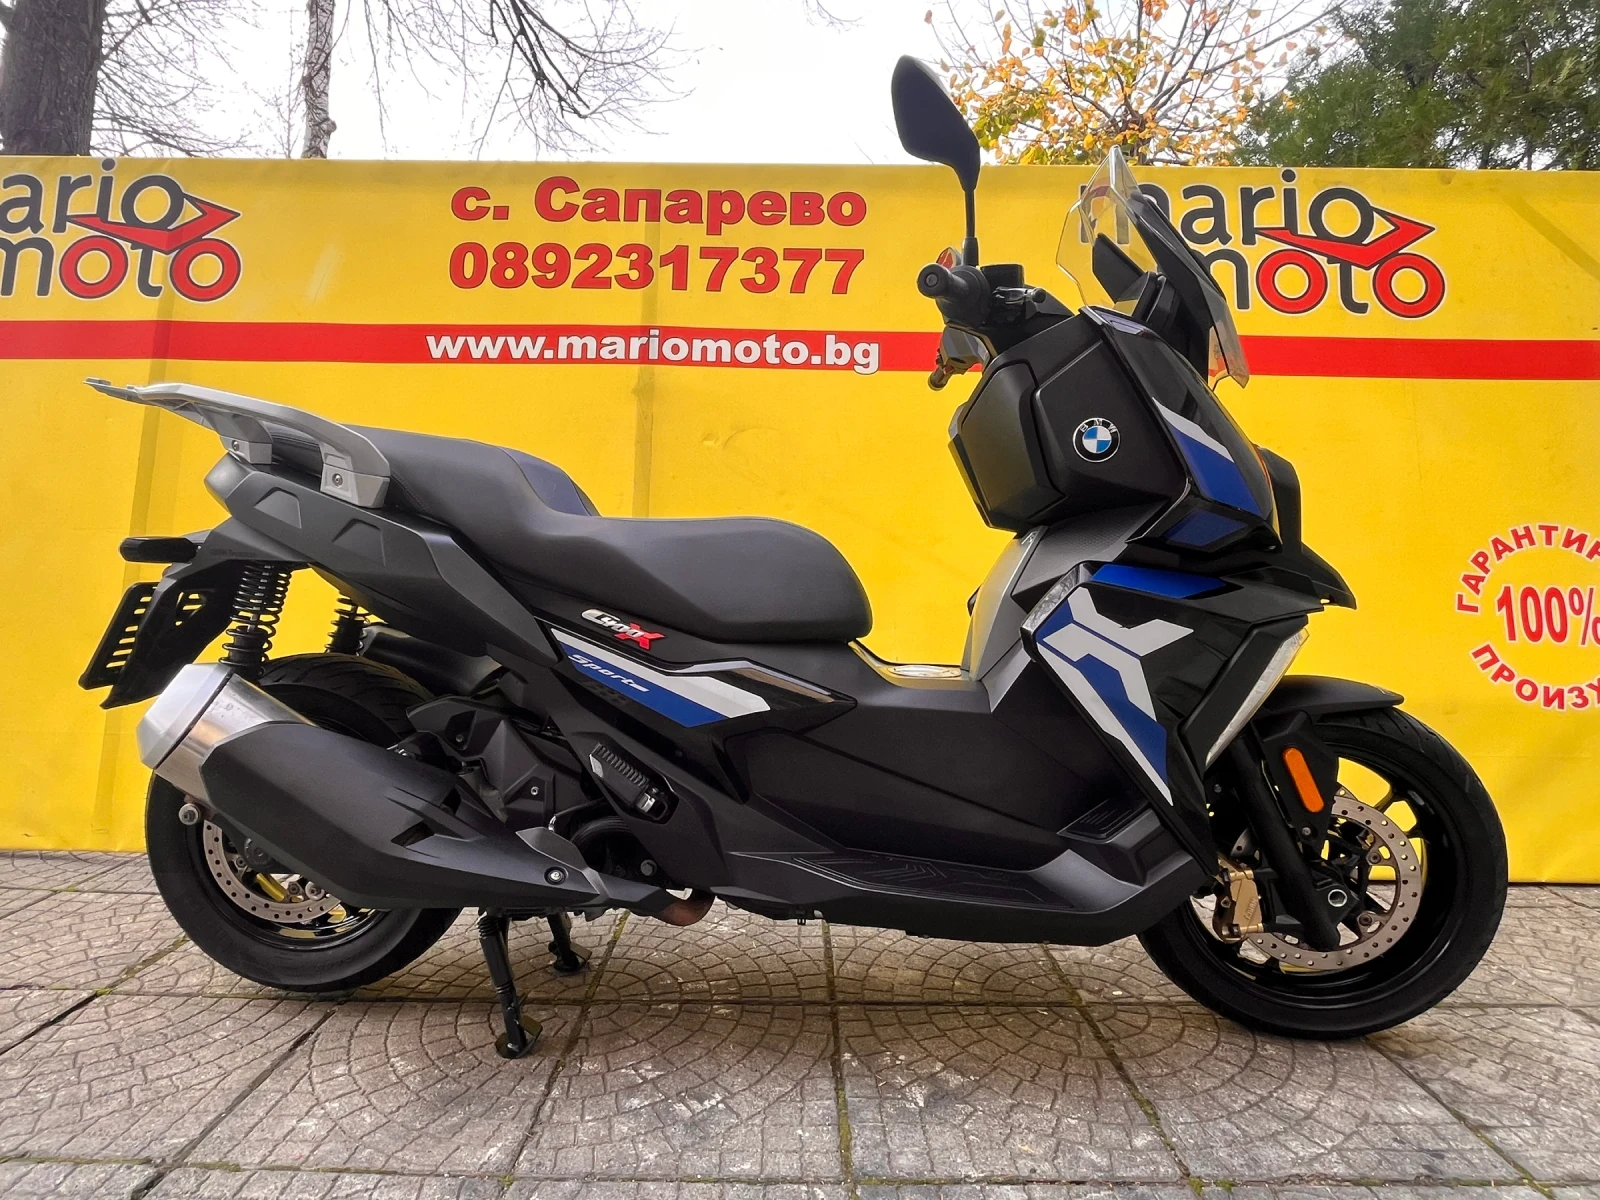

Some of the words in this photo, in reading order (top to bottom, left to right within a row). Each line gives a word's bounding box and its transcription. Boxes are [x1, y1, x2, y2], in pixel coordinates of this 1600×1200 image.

[534, 176, 867, 236] Сапарево
[449, 242, 865, 294] 0892317377
[426, 329, 881, 375] www.mariomoto.bg
[1080, 418, 1118, 433] BMW
[1497, 586, 1600, 646] 100%
